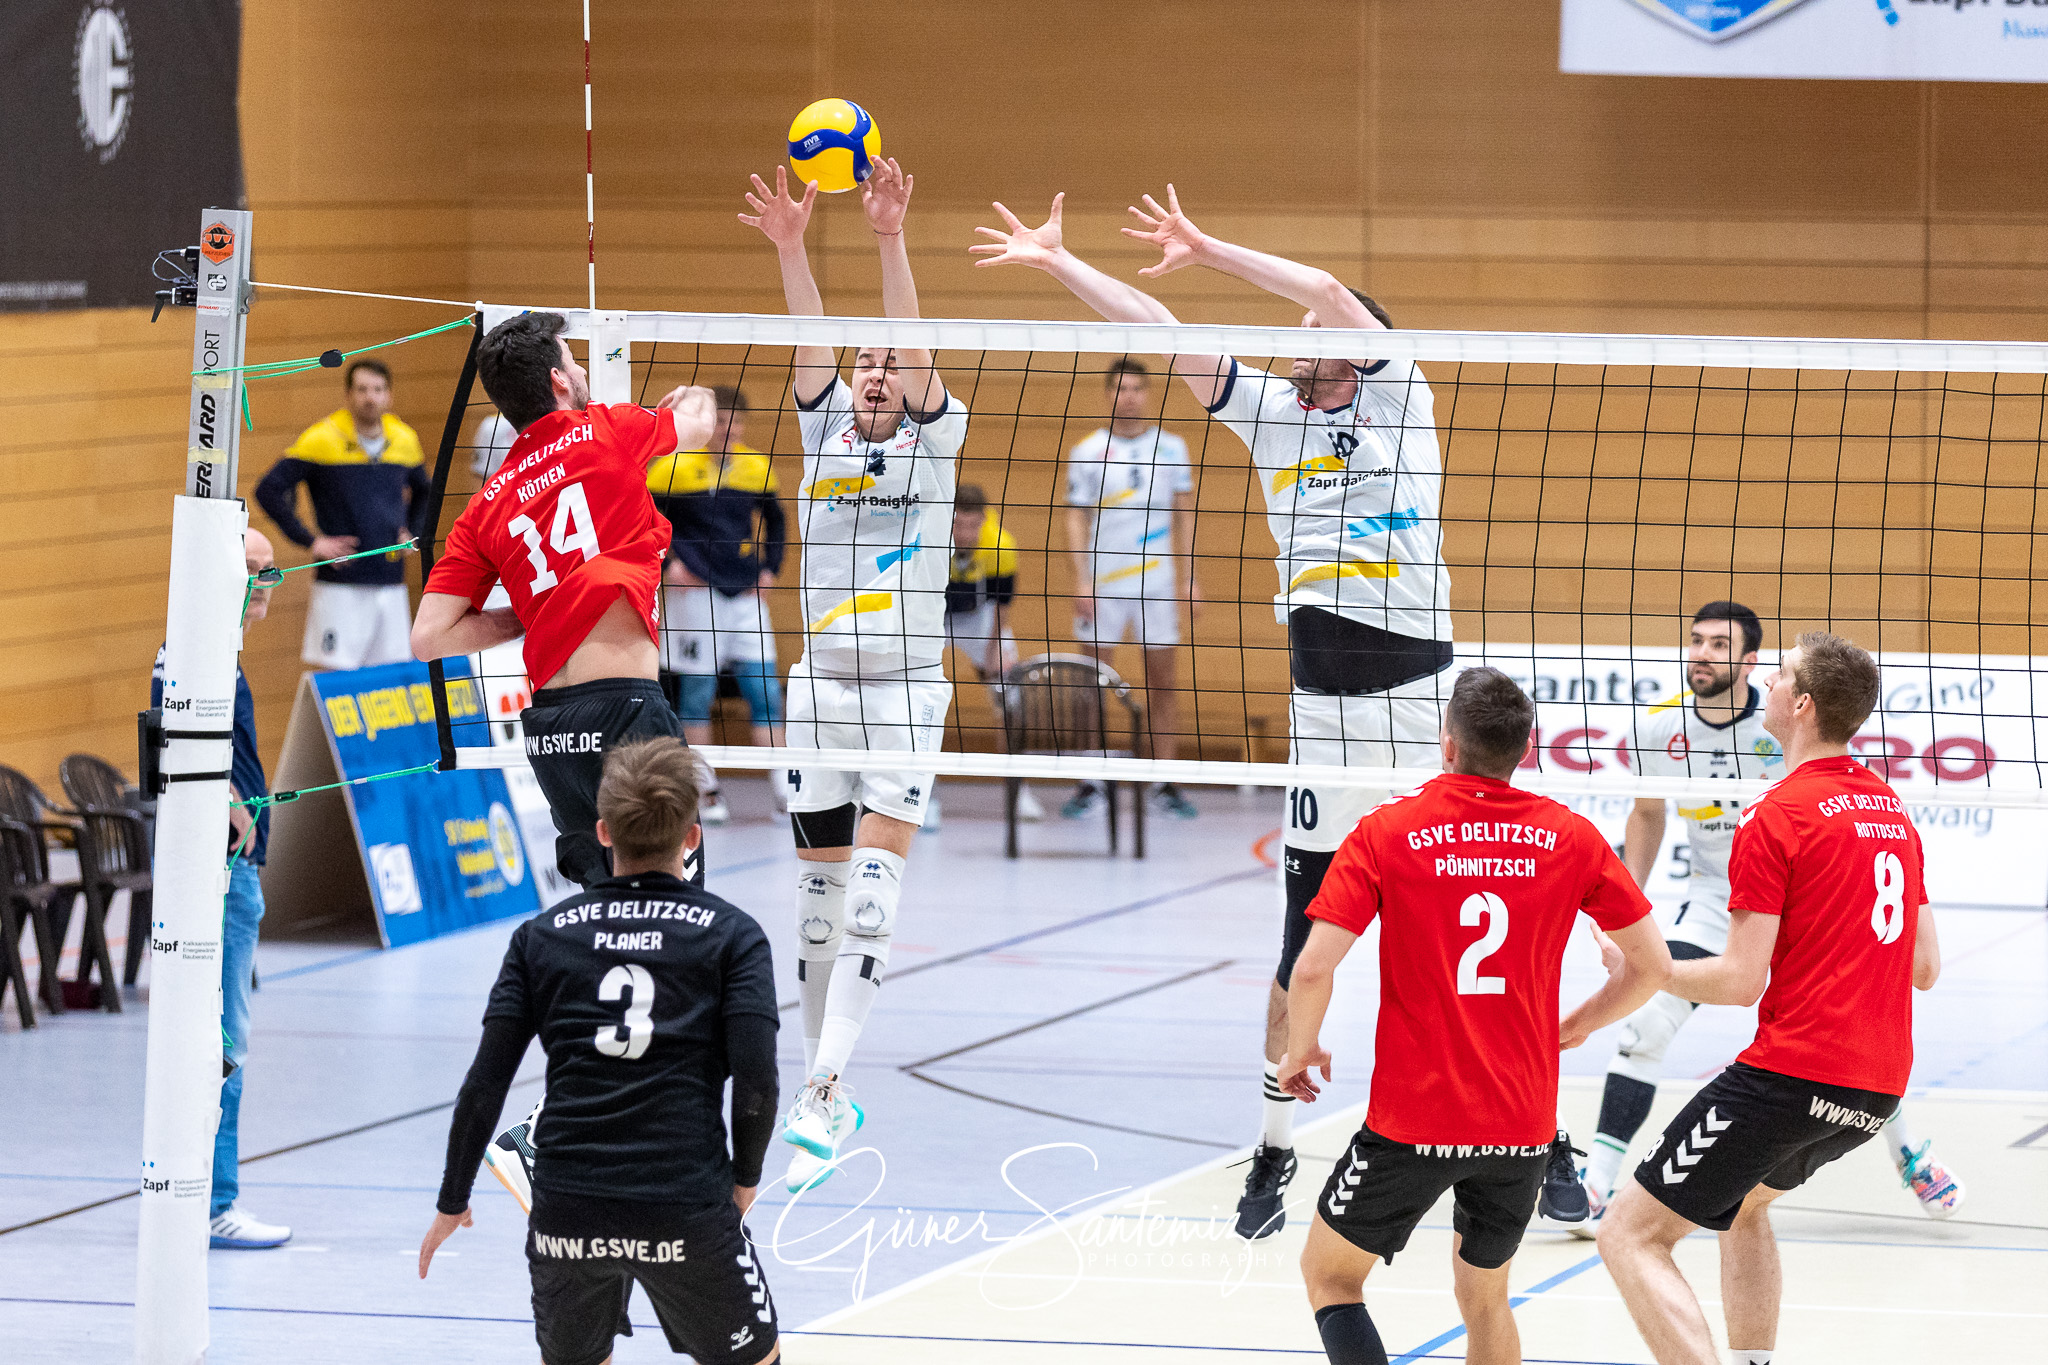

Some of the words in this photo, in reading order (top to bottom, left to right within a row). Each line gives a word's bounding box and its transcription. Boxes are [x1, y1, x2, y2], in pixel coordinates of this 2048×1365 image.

[803, 135, 820, 148] FIVB
[202, 329, 220, 377] PORT
[195, 393, 216, 499] ERARD
[483, 468, 516, 501] GSVE
[518, 424, 593, 473] DELITZSCH
[516, 463, 566, 503] KÖTHEN
[1308, 477, 1338, 490] Zapf
[836, 495, 866, 507] Zapf
[507, 481, 601, 598] 14
[164, 697, 192, 712] Zapf
[1290, 786, 1319, 831] 10
[1818, 794, 1855, 818] GSVE
[1853, 794, 1908, 819] DELITZS
[1407, 823, 1456, 850] GSVE
[1461, 822, 1557, 852] DELITZSCH
[1435, 854, 1536, 877] PÖHNITZSCH
[1870, 850, 1905, 945] 8
[554, 902, 602, 928] GSVE
[608, 900, 716, 928] DELITZSCH
[152, 939, 179, 953] Zapf
[594, 931, 663, 950] PLANER
[1456, 891, 1509, 995] 2
[594, 963, 656, 1060] 3
[143, 1178, 170, 1193] Zapf
[534, 1230, 686, 1263] WWW.GSVE.DE
